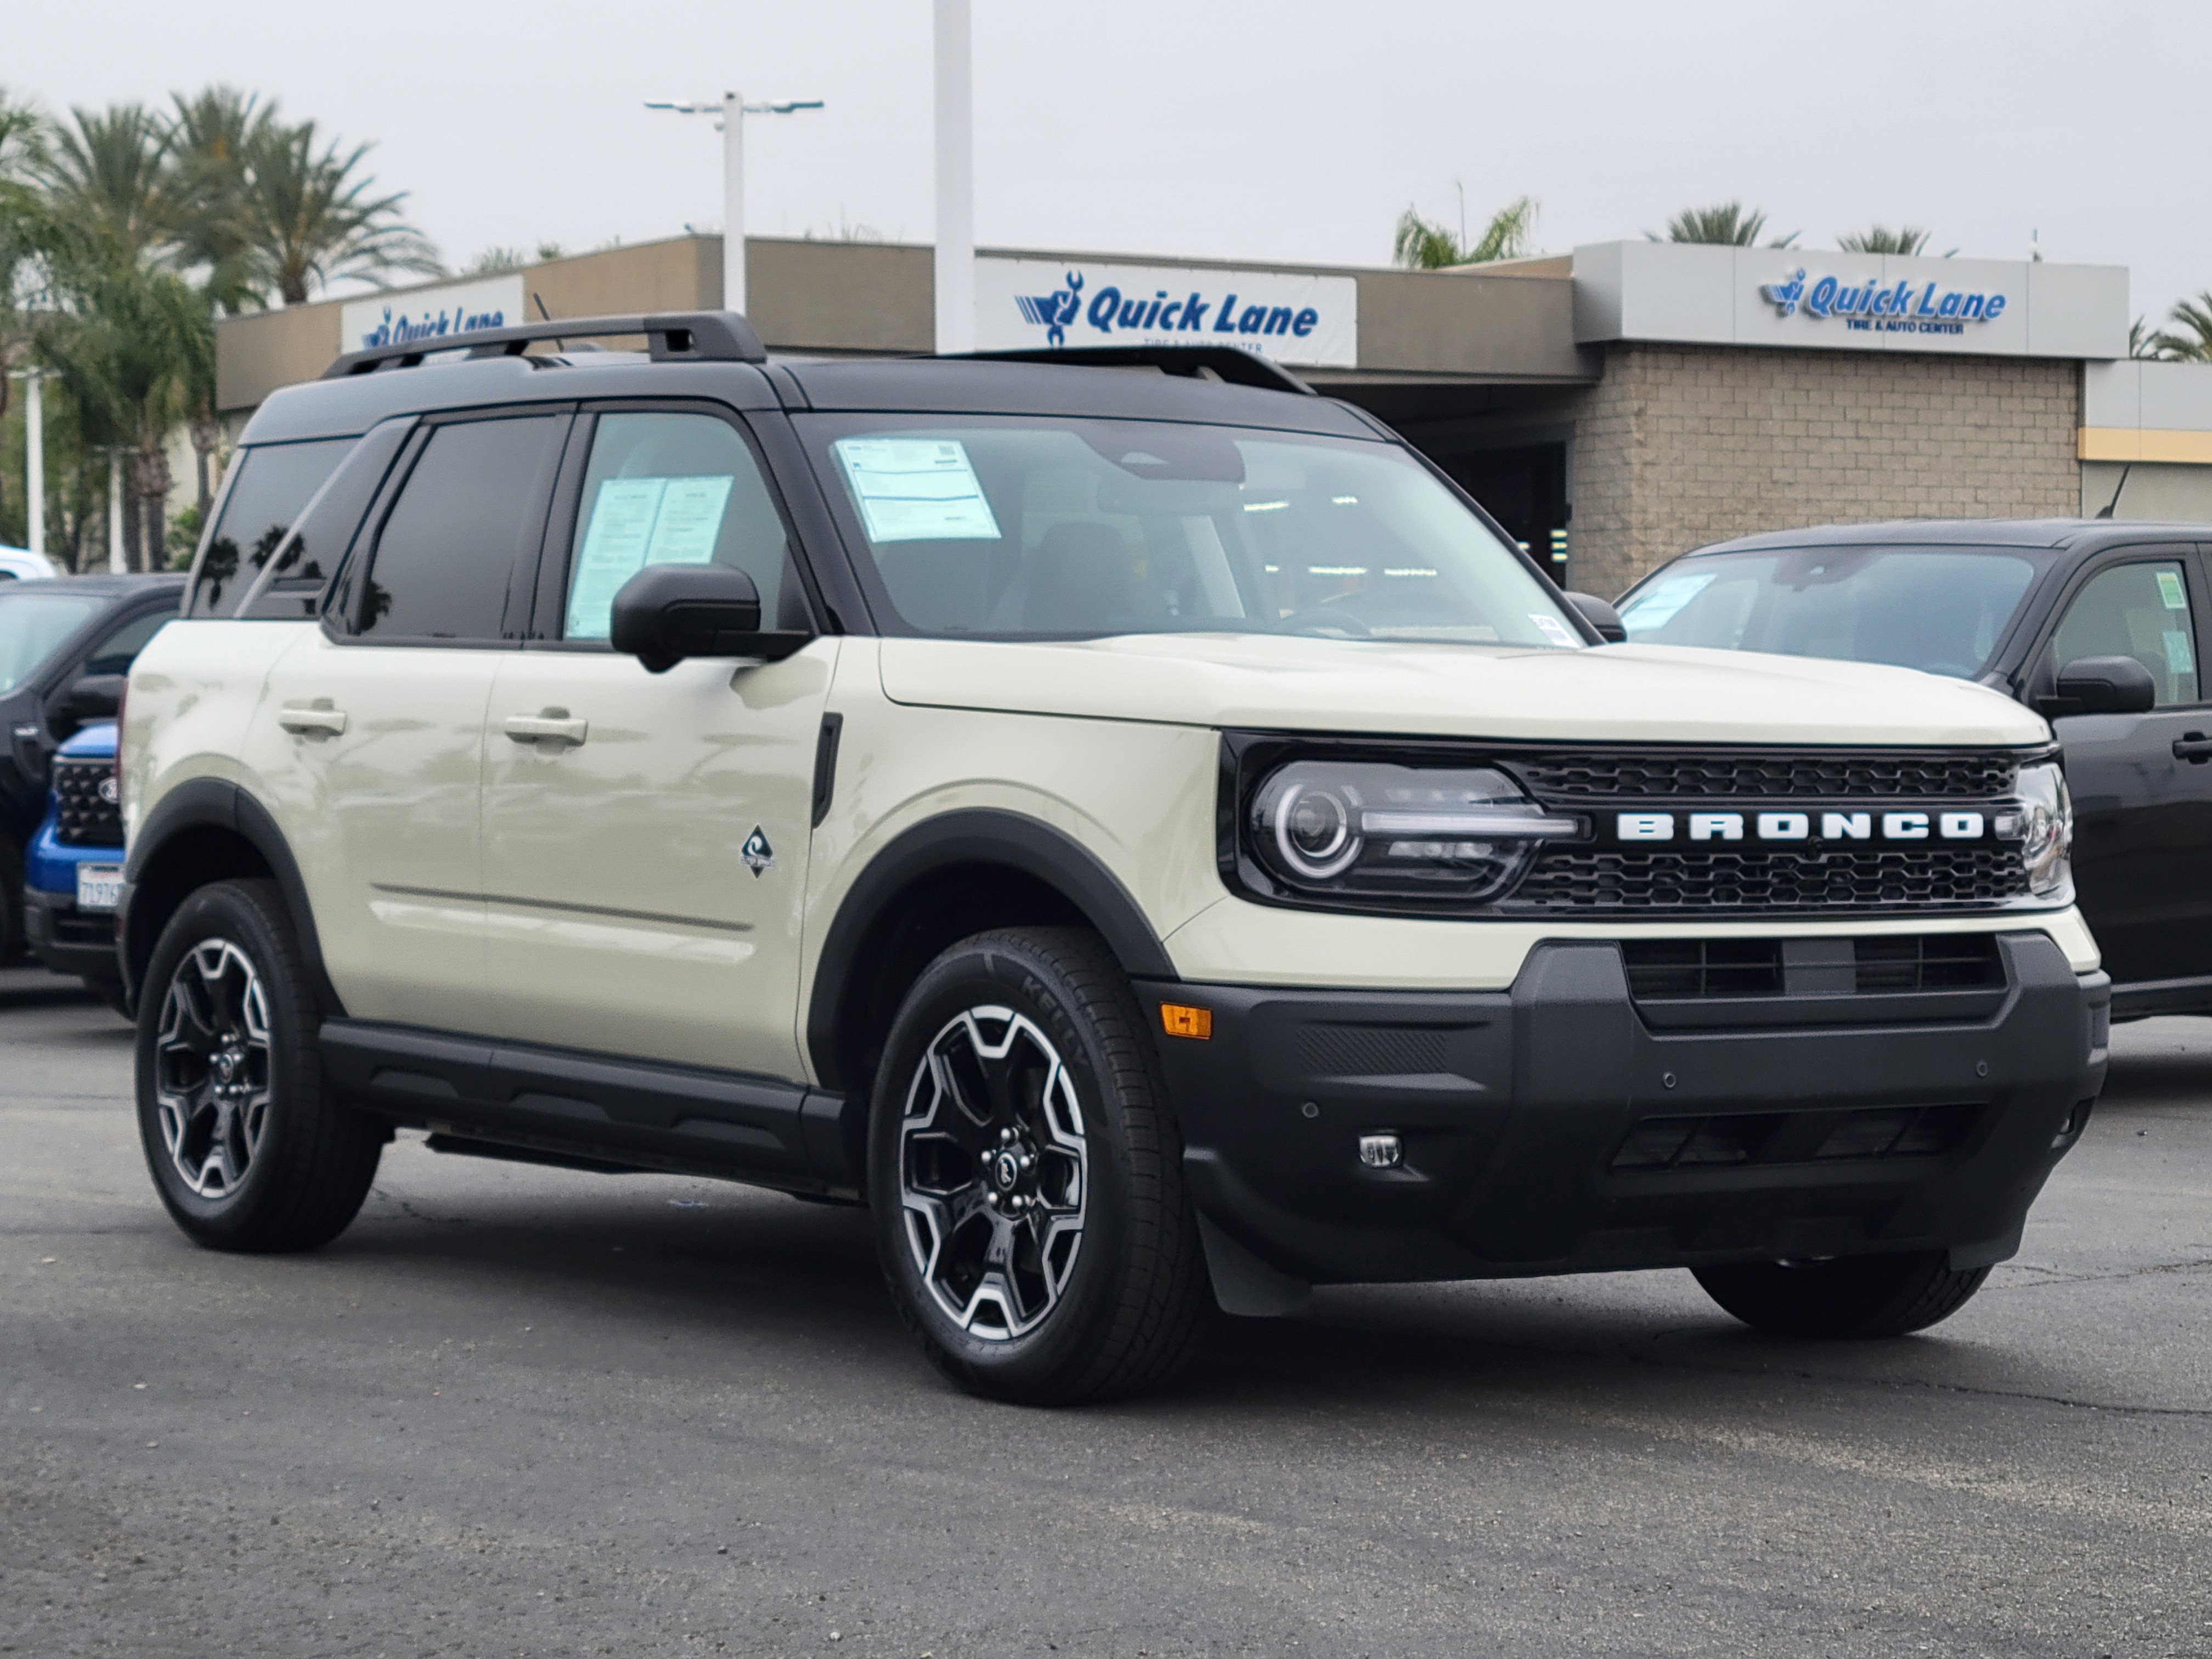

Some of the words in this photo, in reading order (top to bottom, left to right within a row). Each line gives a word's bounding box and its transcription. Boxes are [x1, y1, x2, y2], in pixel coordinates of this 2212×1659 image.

[1087, 286, 1211, 333] Quick
[1213, 294, 1318, 337] Lane
[1810, 276, 1915, 317] Quick
[1918, 282, 2006, 320] Lane
[1847, 320, 1873, 331] TIRE
[1876, 321, 1884, 331] &
[1886, 321, 1917, 333] AUTO
[1918, 323, 1965, 335] CENTER
[1617, 812, 1984, 840] BRONCO
